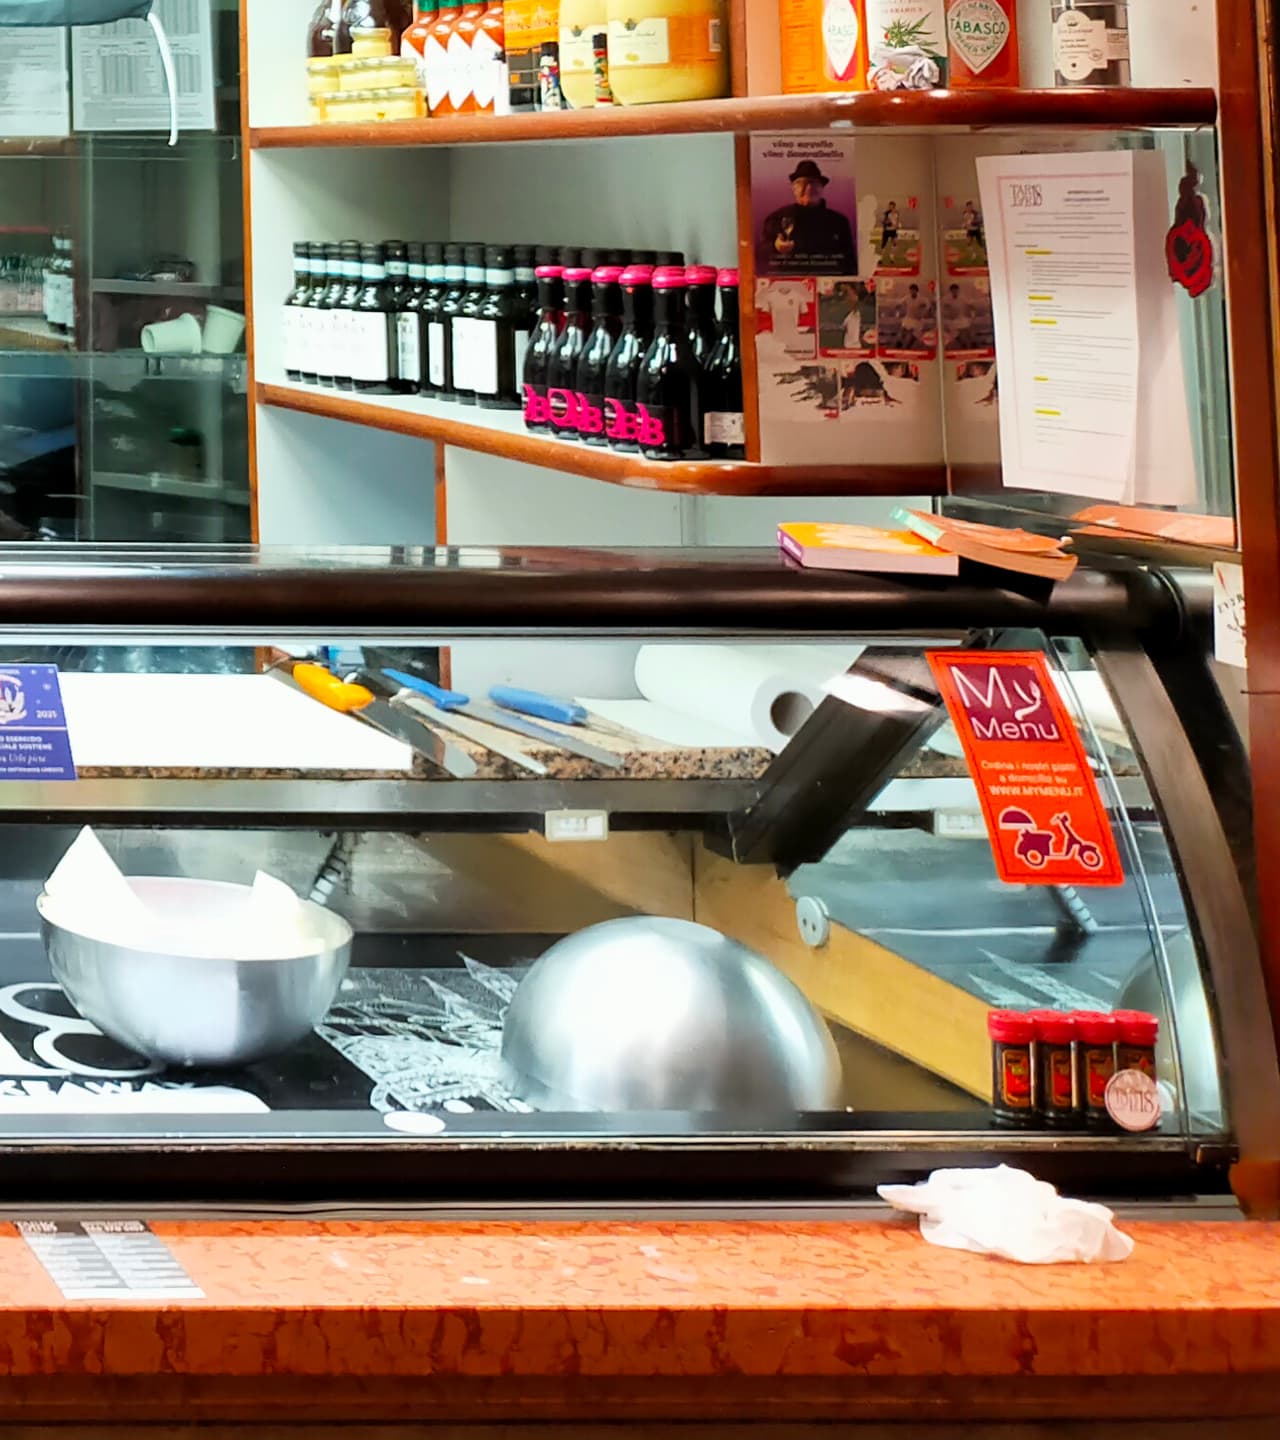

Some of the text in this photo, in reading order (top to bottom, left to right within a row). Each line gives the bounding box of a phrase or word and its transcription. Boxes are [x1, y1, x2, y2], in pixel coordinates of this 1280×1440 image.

[950, 19, 1006, 37] TABASCO
[950, 665, 1042, 721] My
[970, 716, 1060, 741] Menu
